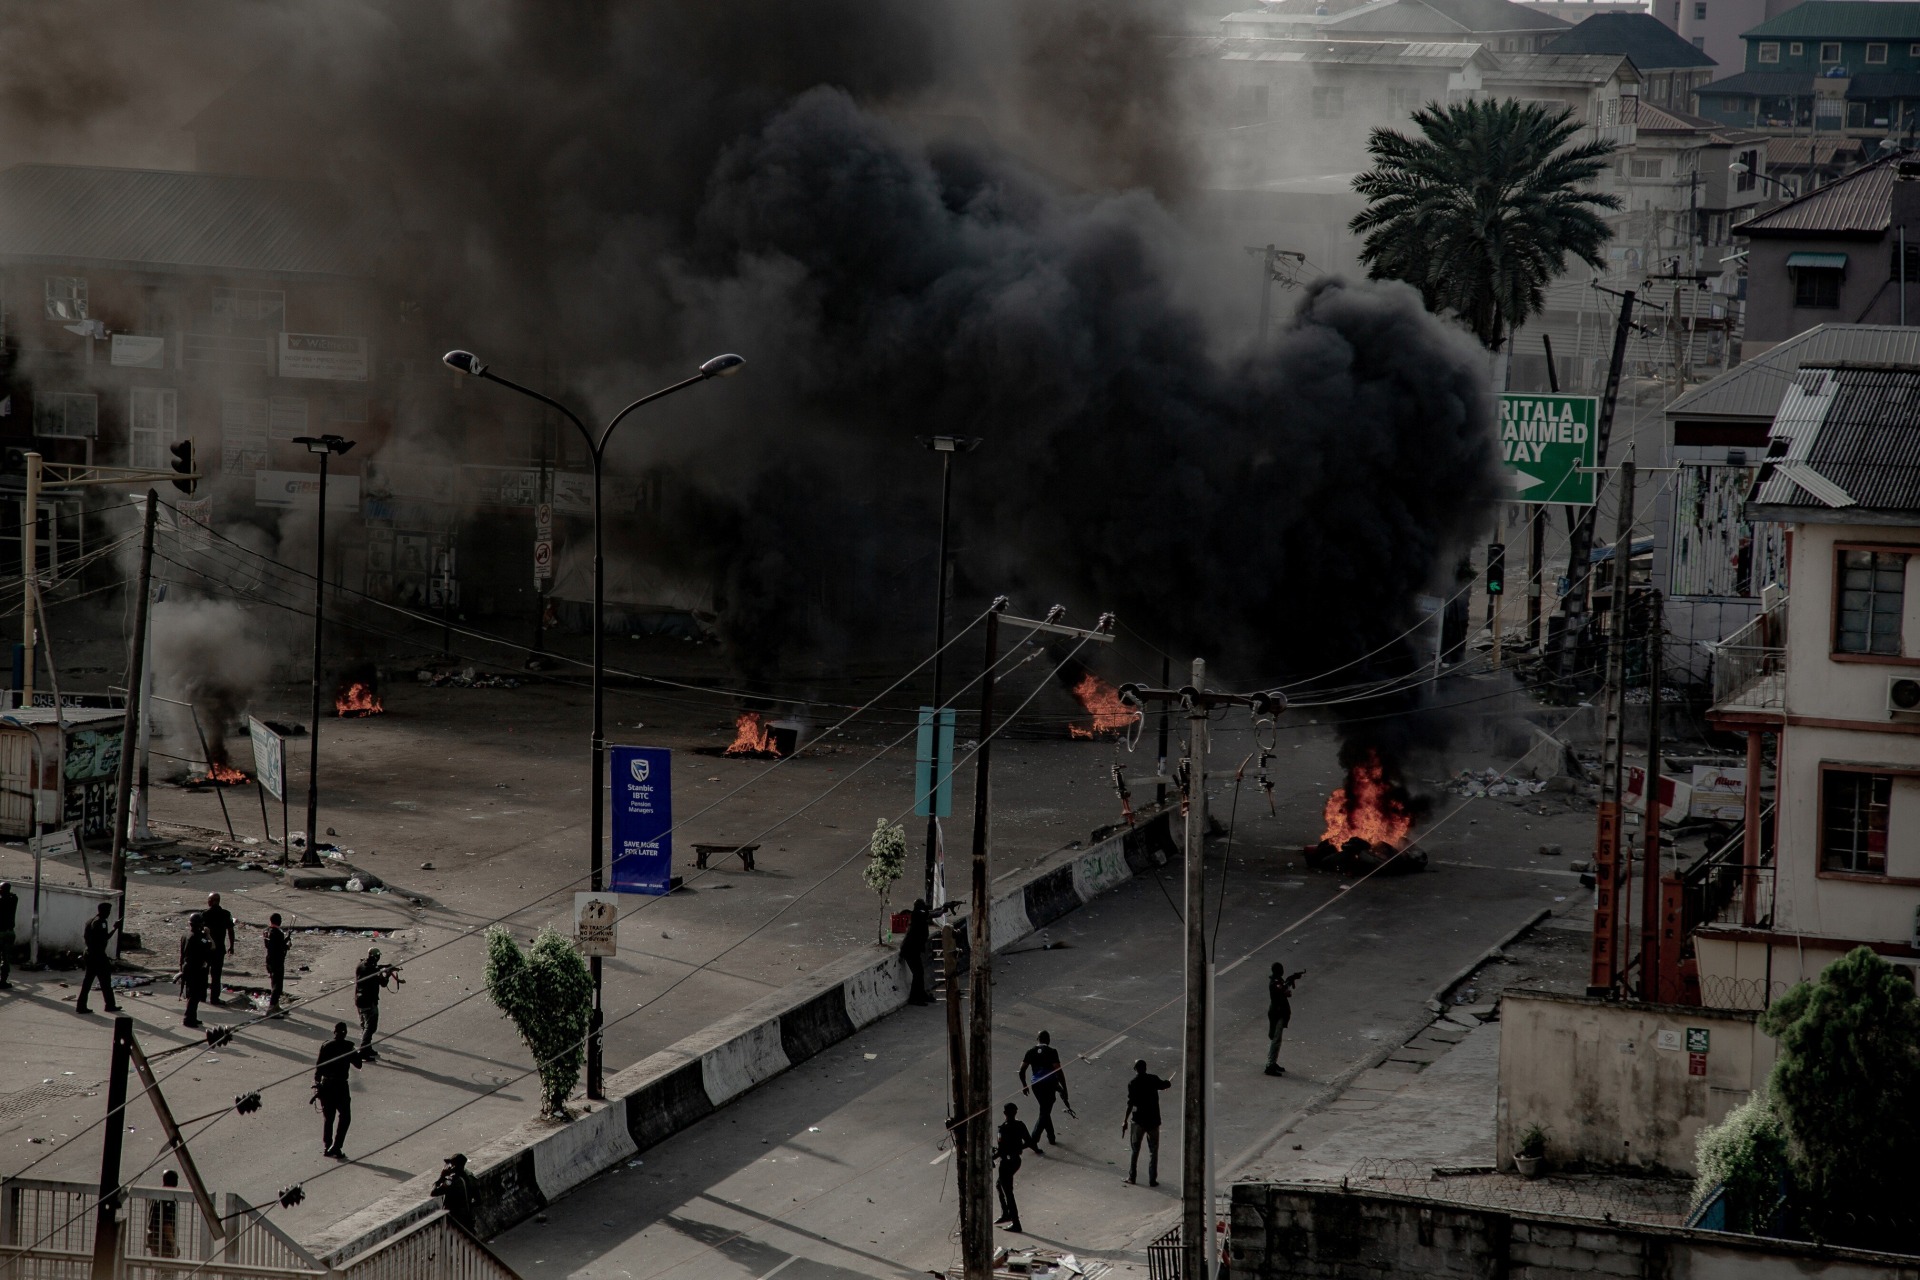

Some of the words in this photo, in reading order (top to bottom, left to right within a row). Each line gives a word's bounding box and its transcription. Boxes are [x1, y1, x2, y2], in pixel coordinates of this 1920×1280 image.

[1497, 420, 1589, 444] AMMED
[627, 784, 654, 792] Stanbic
[632, 792, 649, 800] IBTC
[630, 800, 652, 808] Pension
[628, 806, 654, 815] Managers
[623, 840, 640, 848] SAVE
[640, 841, 660, 849] MORE
[638, 849, 659, 857] LATER
